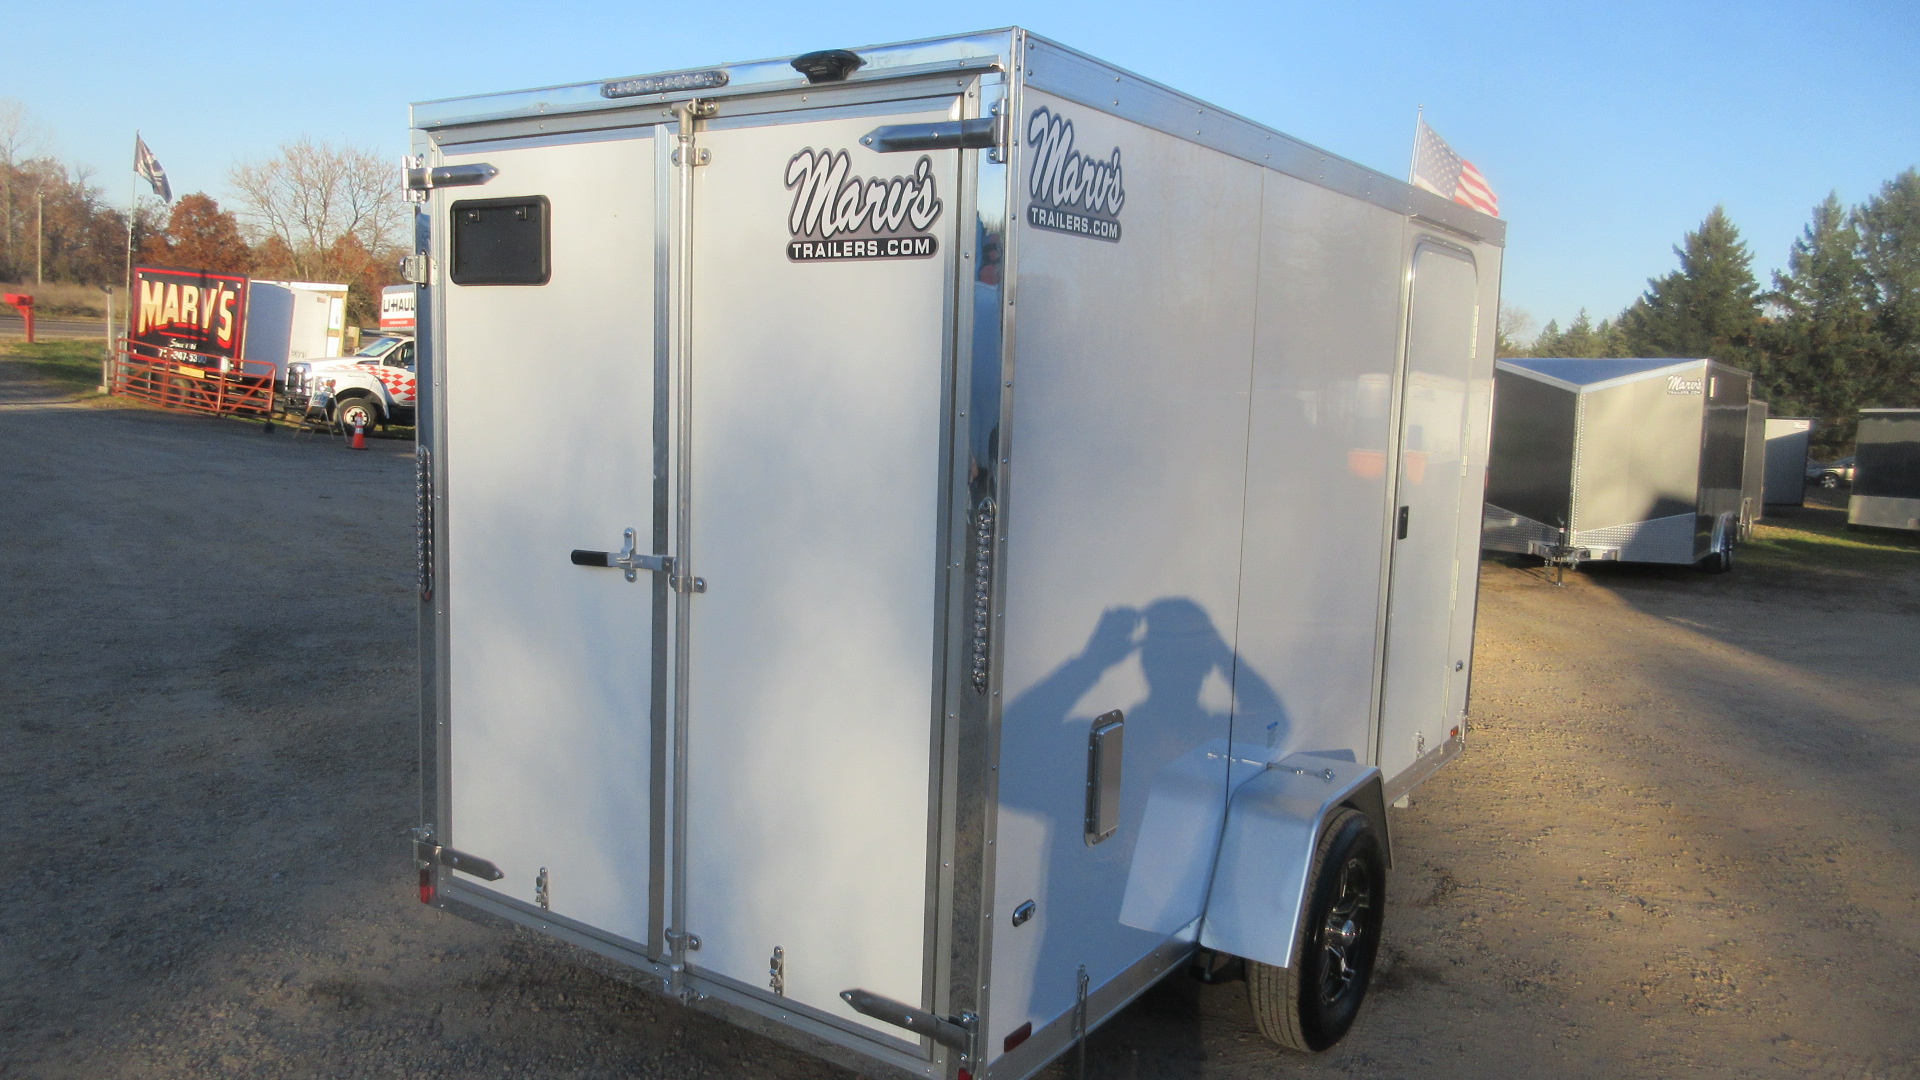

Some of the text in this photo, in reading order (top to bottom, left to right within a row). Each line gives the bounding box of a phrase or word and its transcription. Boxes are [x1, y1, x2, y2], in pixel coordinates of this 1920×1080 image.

[785, 147, 942, 239] Marv's
[1031, 207, 1118, 238] TRAILERS.COM
[792, 238, 930, 258] TRAILERS.COM
